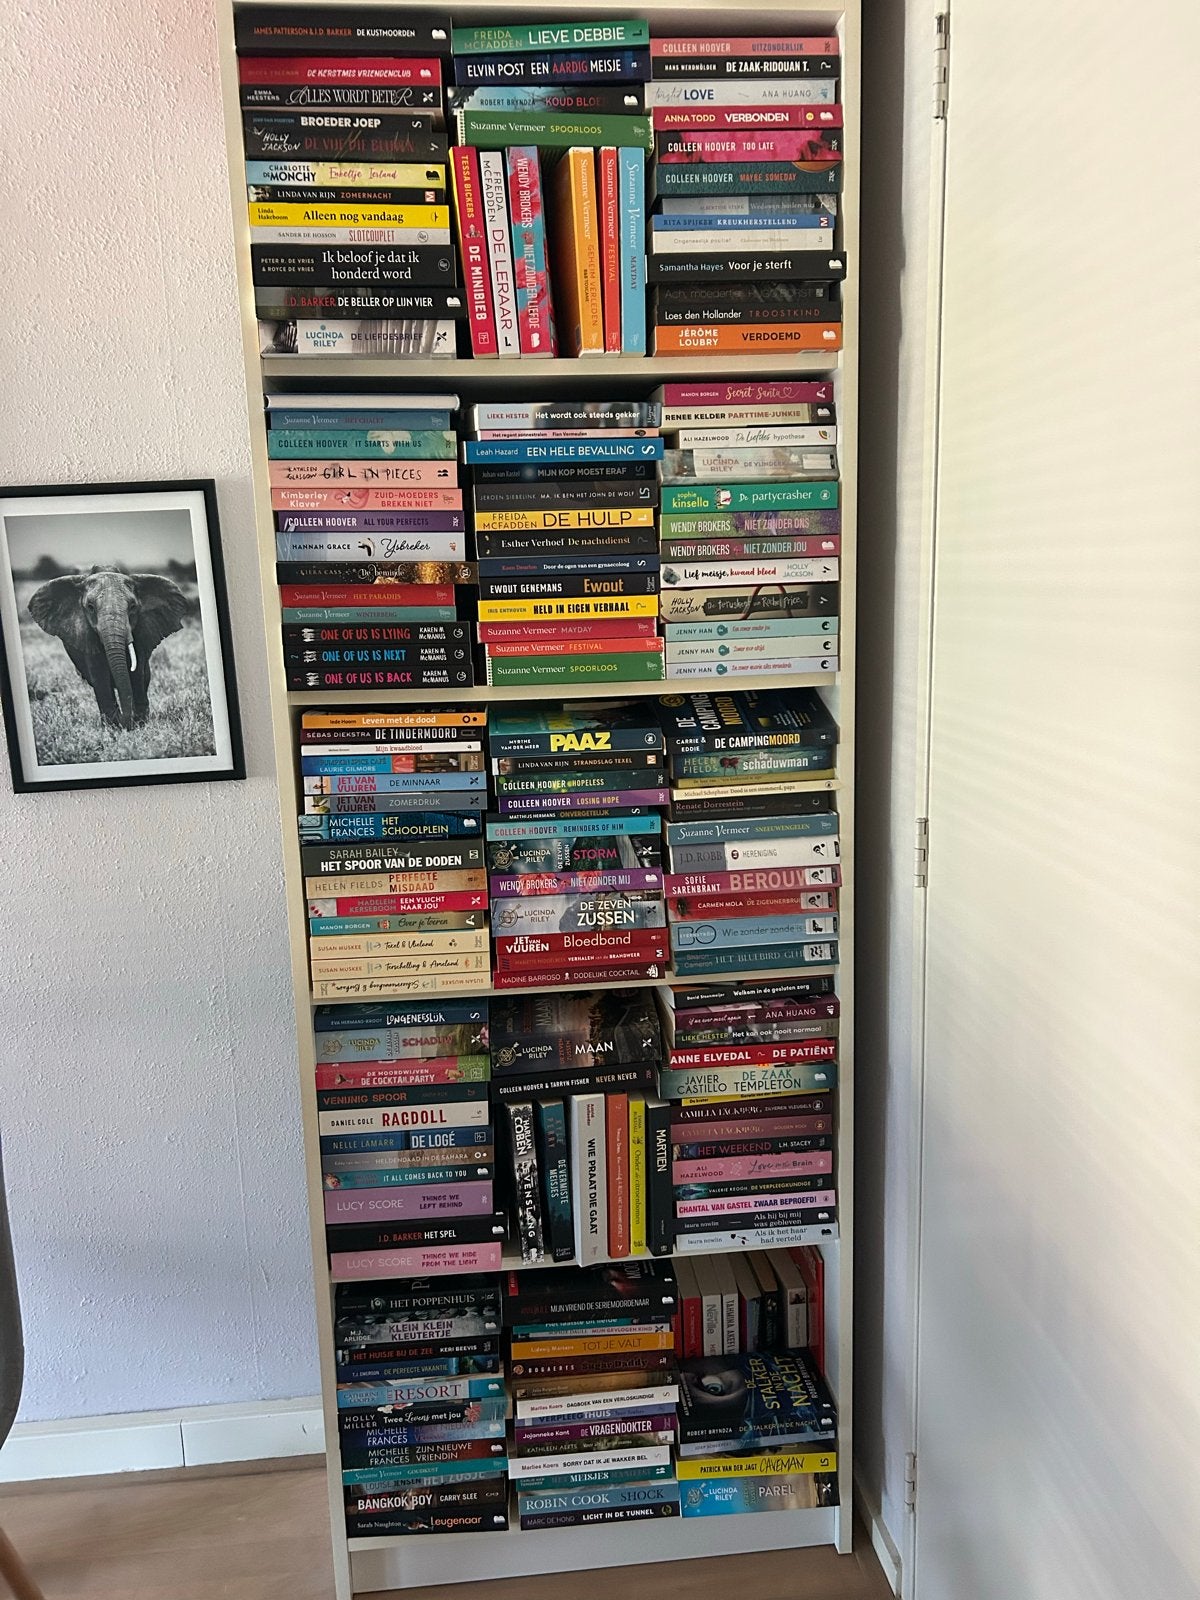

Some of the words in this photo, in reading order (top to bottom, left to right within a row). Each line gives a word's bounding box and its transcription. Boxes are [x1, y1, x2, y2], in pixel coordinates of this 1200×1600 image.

[367, 29, 415, 37] KUSTMOORDEN
[529, 30, 569, 44] LIEVE
[573, 27, 625, 42] DEBBIE
[468, 64, 495, 77] ELVIN
[498, 63, 524, 76] POST
[531, 62, 549, 74] EEN
[552, 60, 587, 73] AARDIG
[590, 59, 621, 72] MEISJE
[684, 89, 714, 100] LOVE
[301, 117, 351, 127] BROEDER
[353, 119, 381, 128] JOEP
[725, 113, 789, 122] VERBONDEN
[470, 122, 506, 131] Suzanne
[509, 123, 545, 132] Vermeer
[303, 211, 336, 221] Alleen
[340, 212, 359, 223] nog
[361, 211, 404, 223] vandaag
[493, 229, 505, 253] DE
[322, 252, 334, 262] Ik
[337, 251, 373, 263] beloof
[374, 252, 384, 265] je
[387, 252, 405, 263] dat
[407, 252, 419, 263] ik
[469, 246, 481, 261] DE
[728, 261, 750, 270] Voor
[752, 262, 762, 271] je
[765, 260, 792, 269] sterft
[332, 268, 379, 279] honderd
[382, 268, 411, 279] word
[471, 265, 487, 320] MINIBIEB
[495, 260, 512, 330] LERAAR
[679, 329, 718, 337] JÉRÔME
[742, 332, 800, 340] VERDOEMD
[728, 411, 801, 419] PARTTIME-JUNKIE
[527, 448, 546, 457] EEN
[550, 447, 574, 456] HELE
[578, 446, 634, 455] BEVALLING
[281, 492, 327, 500] Kimberley
[677, 492, 697, 500] sophie
[740, 493, 748, 501] De
[752, 490, 812, 503] partycrasher
[673, 499, 709, 508] kinsella
[543, 513, 570, 527] DE
[578, 511, 632, 526] HULP
[670, 546, 696, 556] WENDY
[698, 545, 729, 555] BROKERS
[744, 544, 760, 554] NIET
[762, 542, 791, 553] ZONDER
[793, 542, 807, 552] JOU
[490, 585, 517, 593] EWOUT
[521, 583, 562, 592] GENEMANS
[584, 579, 623, 593] Ewout
[322, 651, 340, 661] ONE
[344, 651, 355, 661] OF
[358, 650, 369, 661] US
[373, 650, 382, 660] IS
[384, 650, 406, 660] NEXT
[376, 729, 386, 739] DE
[390, 728, 457, 739] TINDERMOORD
[550, 732, 611, 752] PAAZ
[715, 738, 726, 748] DE
[729, 734, 800, 748] CAMPINGMOORD
[743, 757, 808, 770] schaduwman
[542, 799, 571, 807] HOOVER
[577, 797, 600, 805] LOSING
[330, 818, 374, 827] MICHELLE
[382, 817, 399, 825] HET
[331, 828, 375, 836] FRANCES
[382, 825, 448, 835] SCHOOLPLEIN
[573, 848, 617, 859] STORM
[321, 861, 342, 871] HET
[345, 859, 382, 870] SPOOR
[385, 858, 405, 869] VAN
[409, 857, 422, 867] DE
[426, 855, 462, 867] DODEN
[685, 876, 706, 884] SOFIE
[672, 884, 720, 894] SARENBRANT
[580, 901, 594, 911] DE
[599, 900, 632, 910] ZEVEN
[577, 911, 635, 926] ZUSSEN
[514, 937, 529, 945] JET
[564, 933, 631, 947] Bloedband
[506, 944, 549, 953] VUUREN
[575, 1041, 613, 1054] MAAN
[670, 1055, 700, 1064] ANNE
[704, 1052, 751, 1062] ELVEDAL
[790, 1046, 834, 1056] PATIËNT
[685, 1075, 719, 1085] JAVIER
[742, 1072, 756, 1081] DE
[762, 1069, 792, 1080] ZAAK
[677, 1083, 727, 1095] CASTILLO
[734, 1079, 801, 1092] TEMPLETON
[382, 1110, 447, 1126] RAGDOLL
[412, 1135, 425, 1148] DE
[428, 1131, 455, 1147] LOGÉ
[587, 1139, 595, 1158] WIE
[656, 1129, 667, 1172] MARTIEN
[588, 1161, 596, 1191] PRAAT
[589, 1193, 597, 1208] DIE
[727, 1202, 752, 1210] GASTEL
[754, 1199, 778, 1208] ZWAAR
[780, 1196, 817, 1206] BEPROEFD!
[439, 1230, 456, 1238] SPEL
[390, 1300, 408, 1308] HET
[412, 1294, 475, 1307] POPPENHUIS
[394, 1384, 461, 1400] RESORT
[590, 1421, 652, 1436] VRAGENDOKTER
[416, 1446, 434, 1454] ZIJN
[437, 1443, 472, 1451] NIEUWE
[416, 1453, 458, 1462] VRIENDIN
[760, 1457, 805, 1473] CAVEMAN
[759, 1485, 794, 1497] PAREL
[358, 1496, 408, 1511] BANGKOK
[412, 1494, 432, 1506] BOY
[526, 1499, 567, 1510] ROBIN
[571, 1494, 610, 1505] COOK
[621, 1489, 664, 1501] SHOCK
[583, 1513, 603, 1521] LICHT
[626, 1509, 654, 1517] TUNNEL
[431, 1516, 482, 1527] Leugenaar
